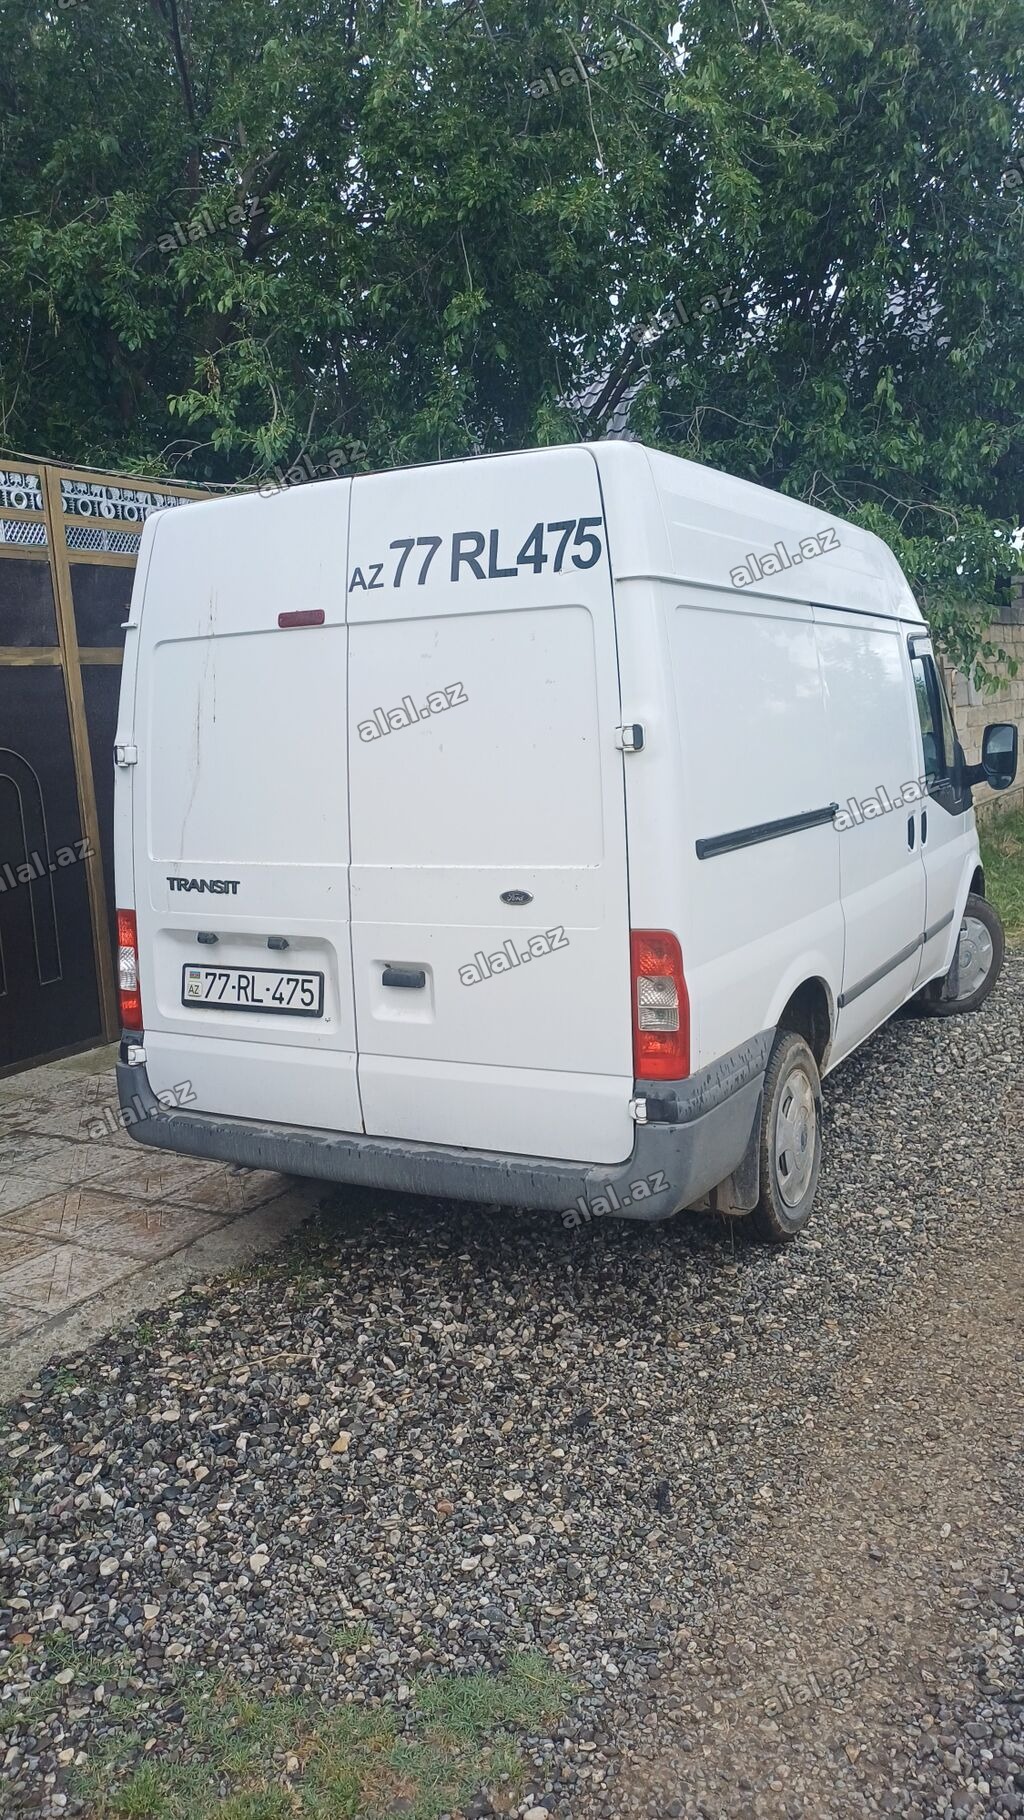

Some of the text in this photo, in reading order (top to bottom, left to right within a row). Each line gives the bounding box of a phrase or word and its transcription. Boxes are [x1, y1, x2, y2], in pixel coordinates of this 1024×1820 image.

[348, 563, 384, 592] AZ
[166, 876, 240, 894] TRANSIT
[188, 984, 201, 995] AZ
